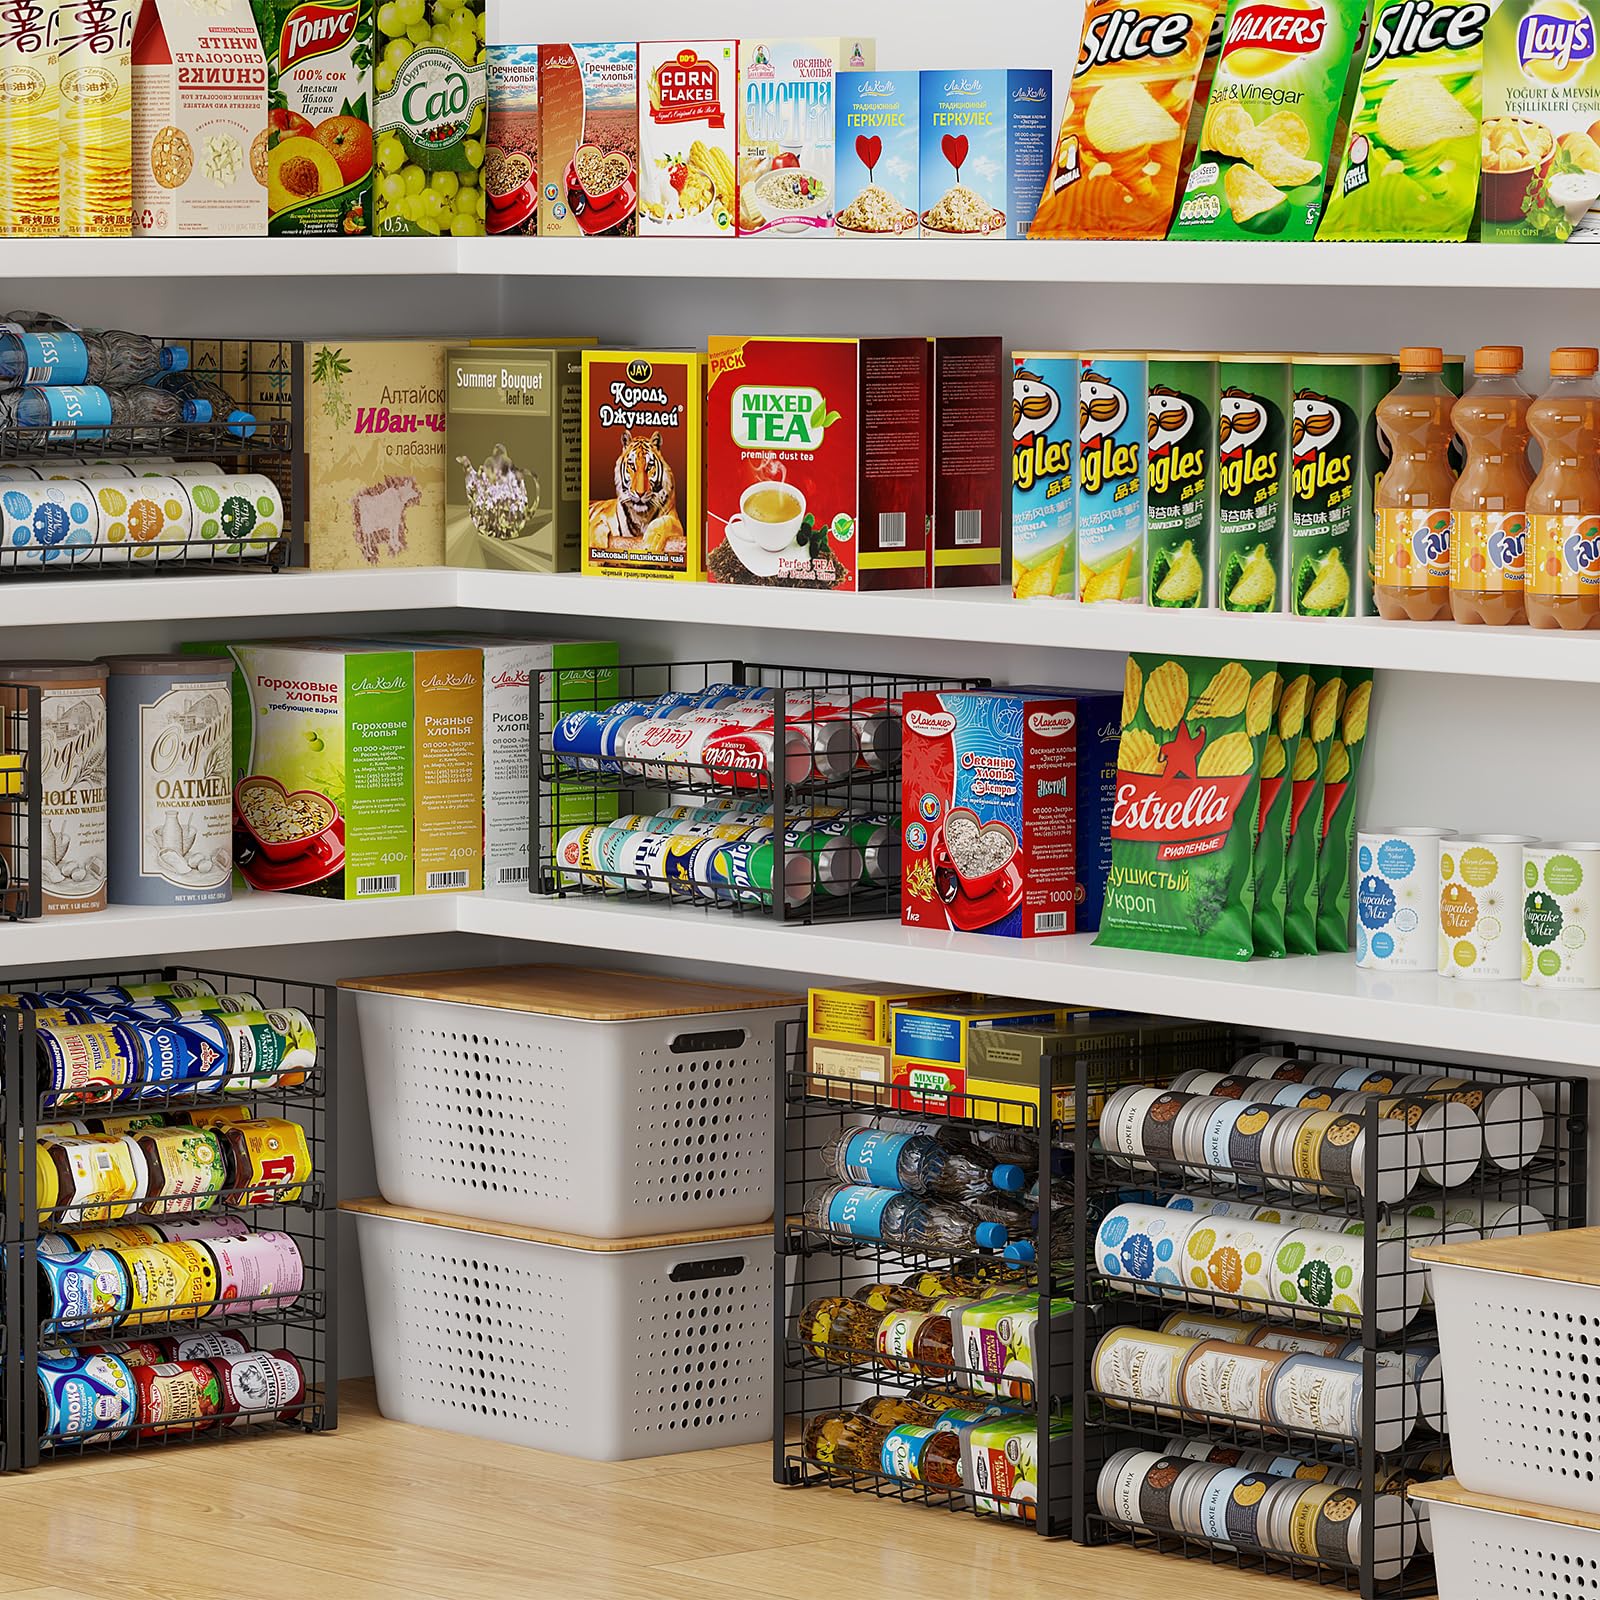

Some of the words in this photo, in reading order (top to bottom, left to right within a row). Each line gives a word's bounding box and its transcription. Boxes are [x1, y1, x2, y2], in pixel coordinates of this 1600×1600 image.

[1227, 10, 1327, 44] WALKERS
[1073, 9, 1191, 77] Slice
[1365, 1, 1489, 72] Slice
[293, 69, 323, 81] 100%
[326, 72, 347, 81] сок
[402, 60, 452, 87] Фруктовый
[488, 64, 535, 76] Гречневые
[585, 62, 634, 74] Гречневые
[800, 68, 832, 78] ХЛОПЬЯ
[503, 74, 535, 83] хлопья
[601, 73, 634, 81] хлопья
[661, 71, 713, 87] CORN
[297, 83, 339, 94] Апельсин
[661, 89, 713, 101] FLAKES
[1229, 86, 1239, 100] &
[1239, 84, 1305, 106] Vinegar
[1506, 87, 1548, 100] YOĞURT
[1551, 87, 1559, 98] &
[301, 94, 334, 105] Яблоко
[402, 73, 470, 126] Сад
[852, 103, 900, 111] ТРАДИЦИОННЫЙ
[938, 101, 987, 110] ТРАДИЦИОННЫЙ
[1505, 99, 1569, 115] YEŞİLLİKLERİ
[301, 104, 334, 115] Персик
[847, 112, 905, 127] ГЕРКУЛЕС
[933, 111, 993, 127] ГЕРКУЛЕС
[711, 353, 744, 373] PACK
[630, 365, 649, 377] JAY
[456, 367, 497, 388] Summer
[501, 368, 543, 392] Bouquet
[506, 390, 520, 406] leaf
[522, 391, 534, 405] tea
[610, 382, 668, 409] Король
[742, 394, 812, 413] MIXED
[600, 405, 679, 430] Джунглей
[742, 412, 811, 443] TEA
[741, 451, 777, 461] premium
[779, 452, 798, 460] dust
[801, 452, 814, 461] tea
[240, 501, 251, 527] Mix
[591, 549, 628, 560] Байховый
[670, 554, 684, 563] чай
[778, 557, 810, 571] Perfect
[812, 559, 835, 571] TEA
[257, 676, 338, 693] Гороховые
[286, 691, 338, 704] хлопья
[268, 703, 314, 713] требующие
[352, 720, 408, 732] Гороховые
[424, 716, 474, 727] Ржаные
[361, 730, 398, 738] хлопья
[427, 726, 471, 737] хлопья
[961, 752, 1016, 770] Овсяные
[973, 768, 1015, 781] хлопья
[1112, 783, 1231, 831] Estrella
[449, 847, 478, 860] 400г
[1163, 838, 1220, 858] РИФЛЕНЫЕ
[380, 852, 408, 864] 400г
[1049, 890, 1073, 902] 1000
[1106, 887, 1157, 914] Укроп
[1359, 890, 1393, 908] Cupcake
[905, 906, 920, 922] 1кг
[1365, 905, 1388, 919] Mix
[1440, 899, 1475, 916] Cupcake
[1447, 912, 1470, 927] Mix
[1524, 907, 1560, 924] Cupcake
[1531, 922, 1555, 936] Mix
[914, 1073, 944, 1085] MIXED
[1129, 1106, 1137, 1121] MIX
[1216, 1118, 1225, 1133] MIX
[1305, 1130, 1314, 1145] MIX
[1228, 1256, 1238, 1281] Mix
[1318, 1269, 1329, 1295] Mix
[1127, 1472, 1135, 1487] MIX
[1213, 1488, 1222, 1503] MIX
[1126, 1488, 1135, 1522] COOKIE
[1302, 1503, 1310, 1519] MIX
[1211, 1504, 1220, 1538] COOKIE
[1300, 1520, 1310, 1554] COOKIE
